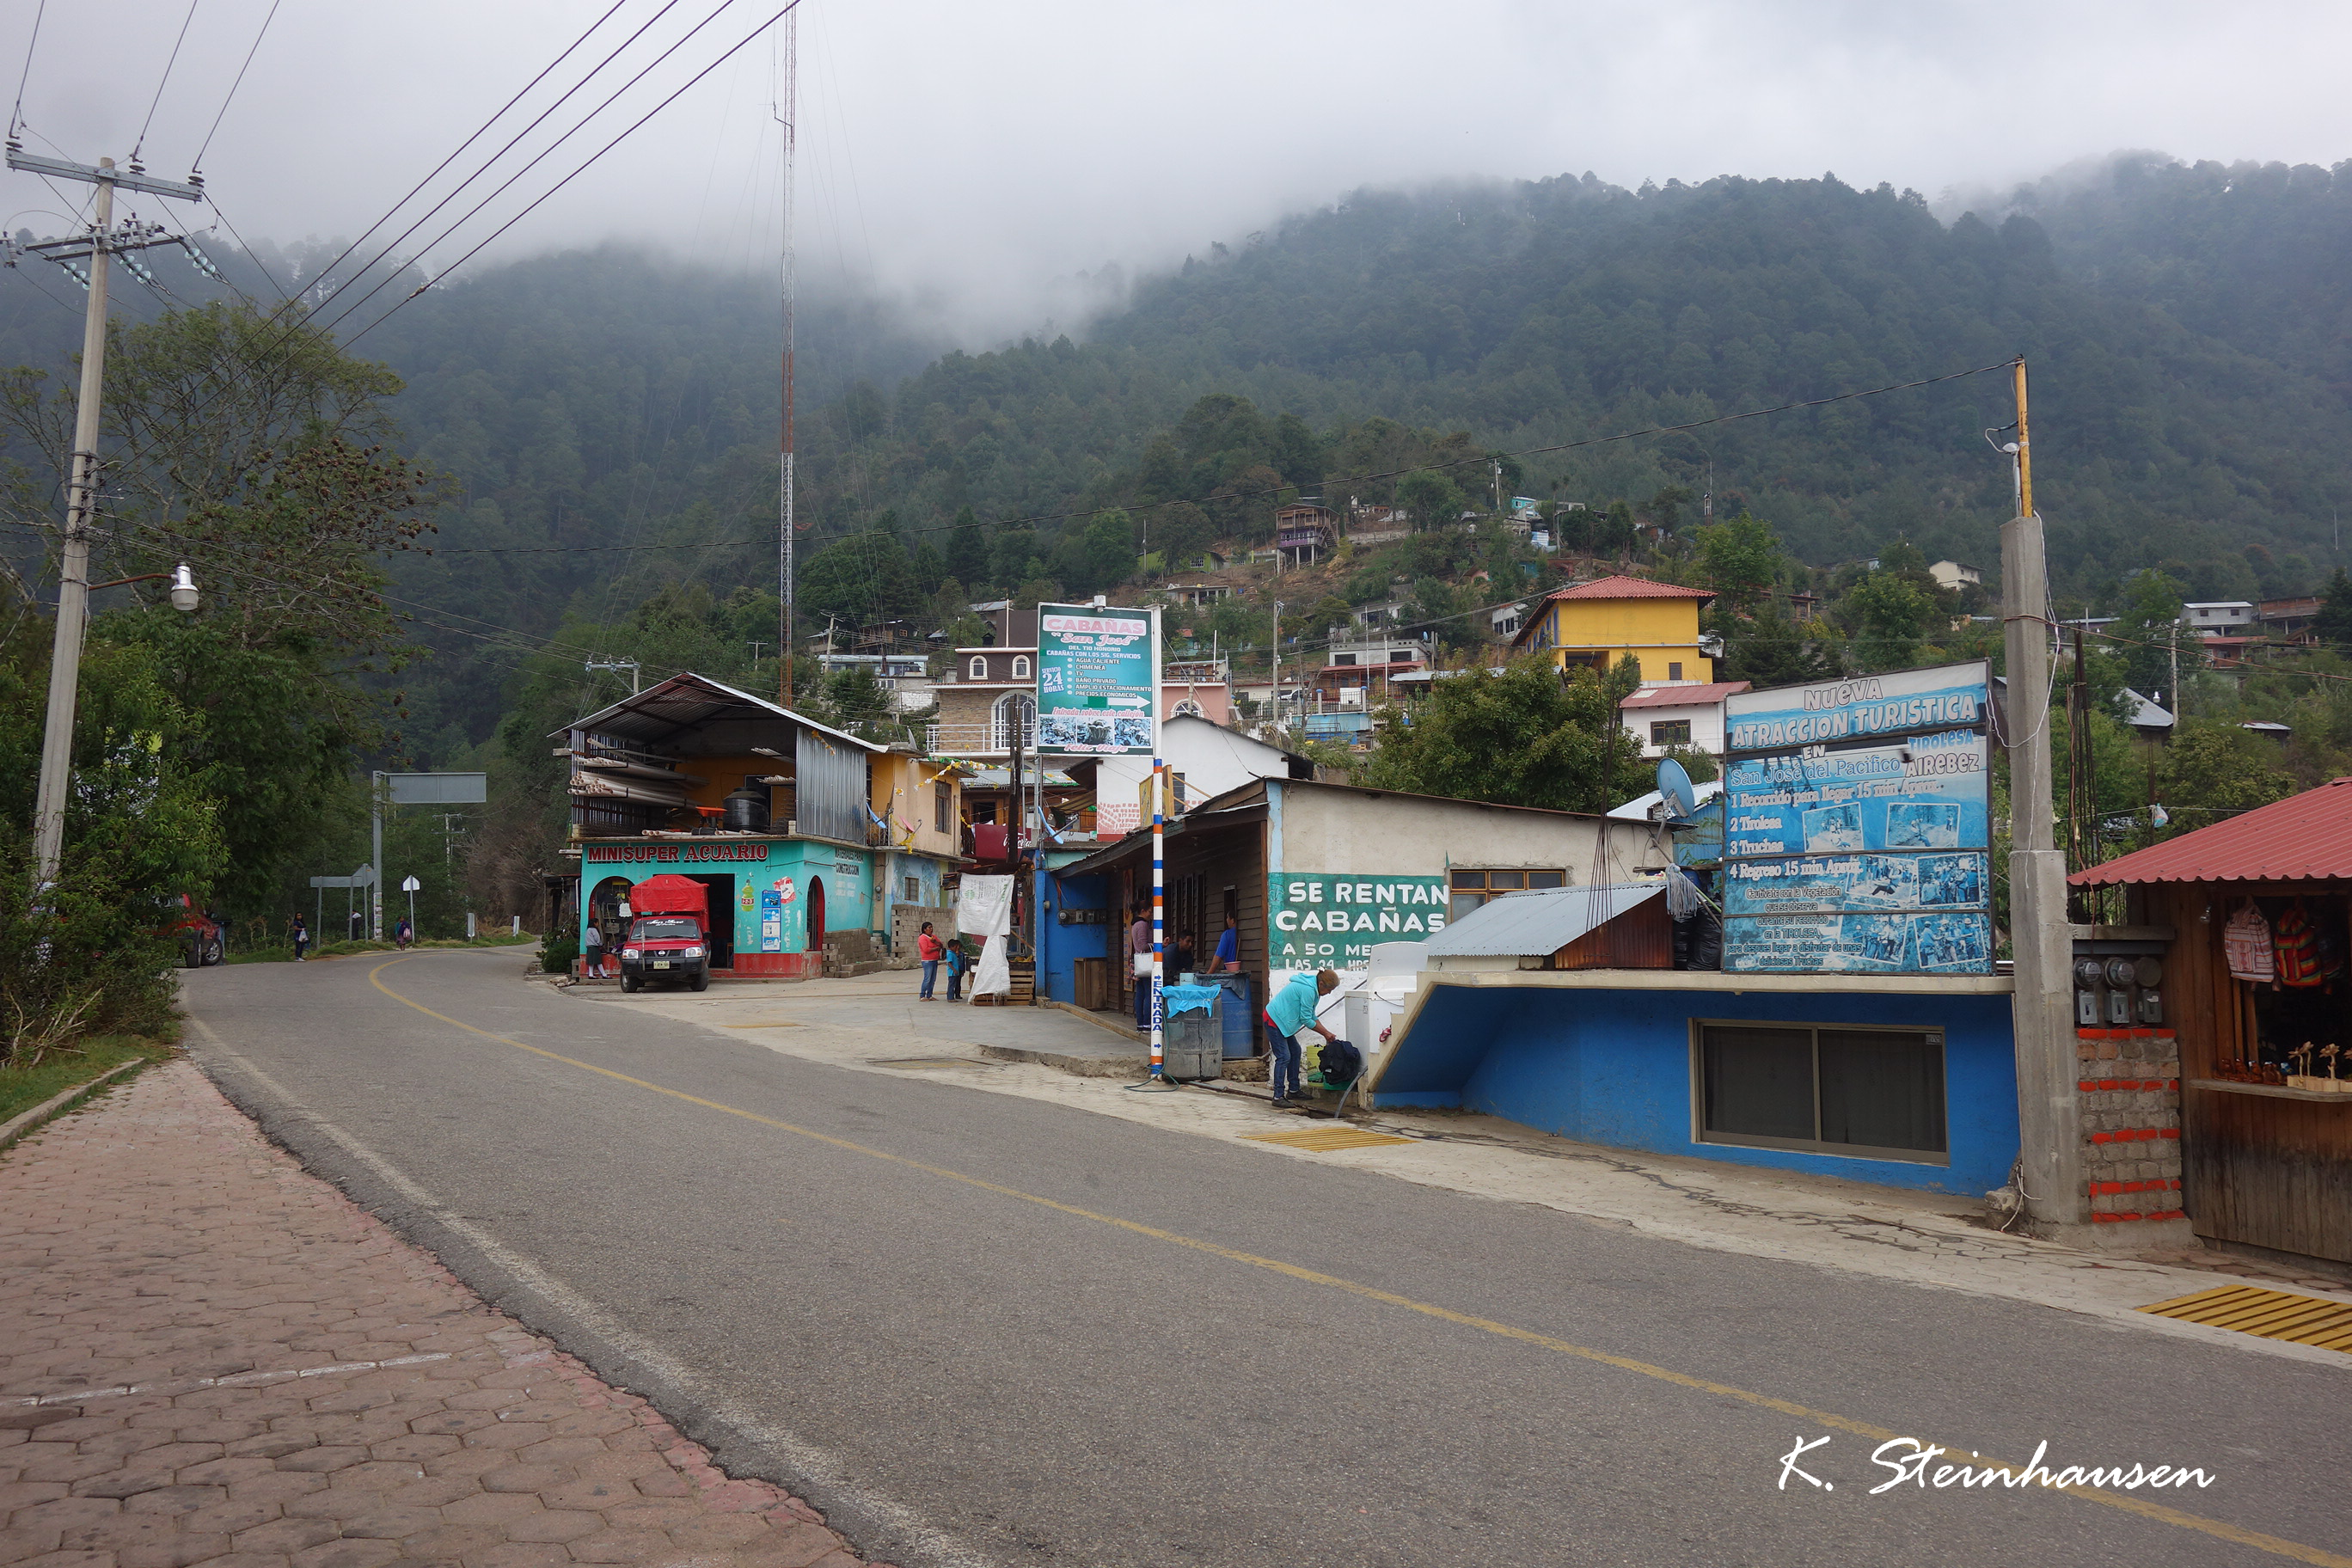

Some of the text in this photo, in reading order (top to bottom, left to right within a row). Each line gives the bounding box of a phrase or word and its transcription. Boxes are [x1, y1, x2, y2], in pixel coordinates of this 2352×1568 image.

[1046, 618, 1144, 634] CABAÑAS
[1042, 671, 1063, 687] 24
[1044, 684, 1064, 694] HORAS
[1052, 707, 1079, 716] Entrada
[1081, 708, 1100, 717] sobre
[1732, 695, 1977, 748] ATRACCION TURISTICA
[1064, 744, 1128, 754] Feliz Viaje
[1802, 744, 1825, 761] EN
[1731, 769, 1761, 786] San
[1765, 763, 1802, 783] José
[1805, 760, 1831, 779] del
[1731, 794, 1737, 808] 1
[1741, 790, 1792, 807] Recorrido
[1792, 791, 1820, 807] para
[1821, 786, 1853, 803] llegar
[1857, 782, 1871, 799] 15
[1730, 815, 1782, 832] 2 Tirolesa
[587, 844, 768, 862] MINISUPER ACUARIO
[1730, 838, 1784, 854] 3 Truchas
[1730, 864, 1737, 878] 4
[1739, 864, 1781, 880] Regreso
[1785, 861, 1798, 876] 15
[1801, 860, 1822, 875] min
[1289, 882, 1449, 904] SE RENTAN
[1779, 889, 1792, 897] con
[1793, 887, 1801, 897] la
[1803, 885, 1841, 898] Vegetación
[1765, 901, 1818, 912] que se observa
[1275, 906, 1445, 933] CABAÑAS
[1756, 916, 1785, 925] durante
[1795, 916, 1829, 925] recorrido
[1764, 930, 1773, 939] en
[1773, 928, 1781, 939] la
[1283, 942, 1296, 955] A
[1305, 943, 1334, 955] 50
[1726, 945, 1743, 954] para
[1772, 942, 1792, 953] llegar
[1798, 941, 1832, 952] disfrutar
[1832, 941, 1842, 951] de
[1842, 943, 1863, 952] unas
[1285, 959, 1311, 971] LAS
[1759, 956, 1824, 966] deliciosas Truchas
[1153, 982, 1162, 1032] ENTRADA
